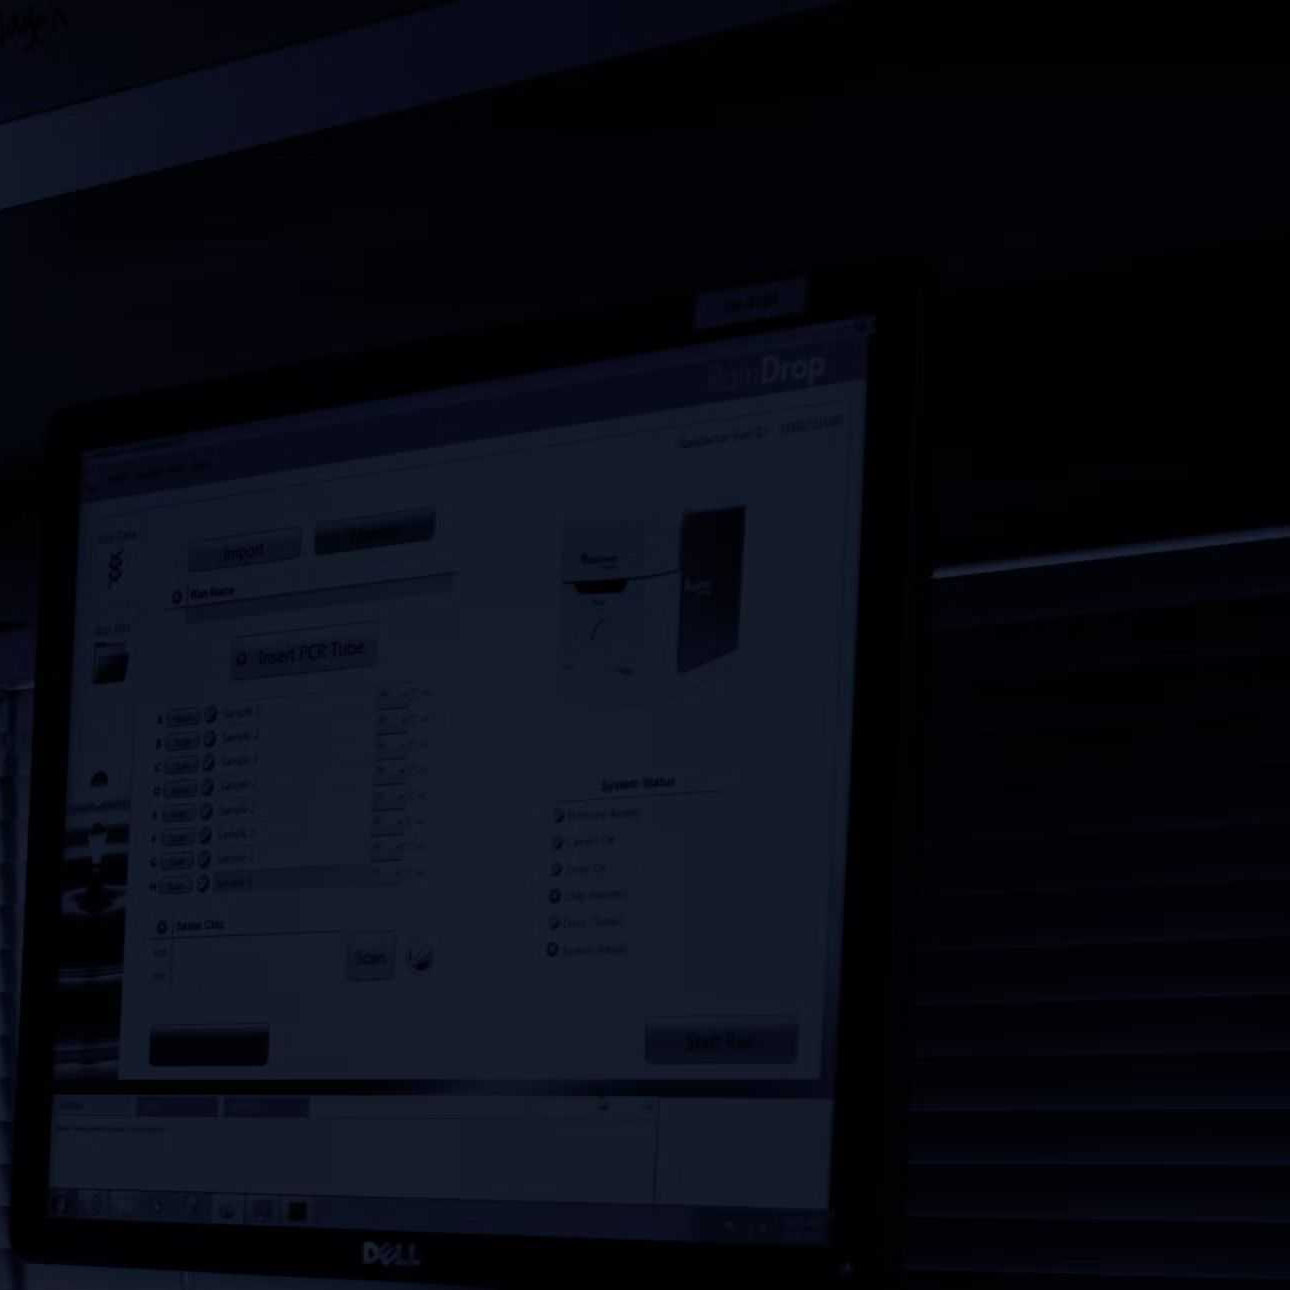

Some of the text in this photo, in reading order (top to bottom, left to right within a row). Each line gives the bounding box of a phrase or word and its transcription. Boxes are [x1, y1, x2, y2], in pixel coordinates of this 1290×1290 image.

[224, 543, 265, 564] Import
[258, 641, 365, 667] Insert PCR Tube
[355, 950, 388, 966] Scan
[362, 1241, 421, 1267] DELL
